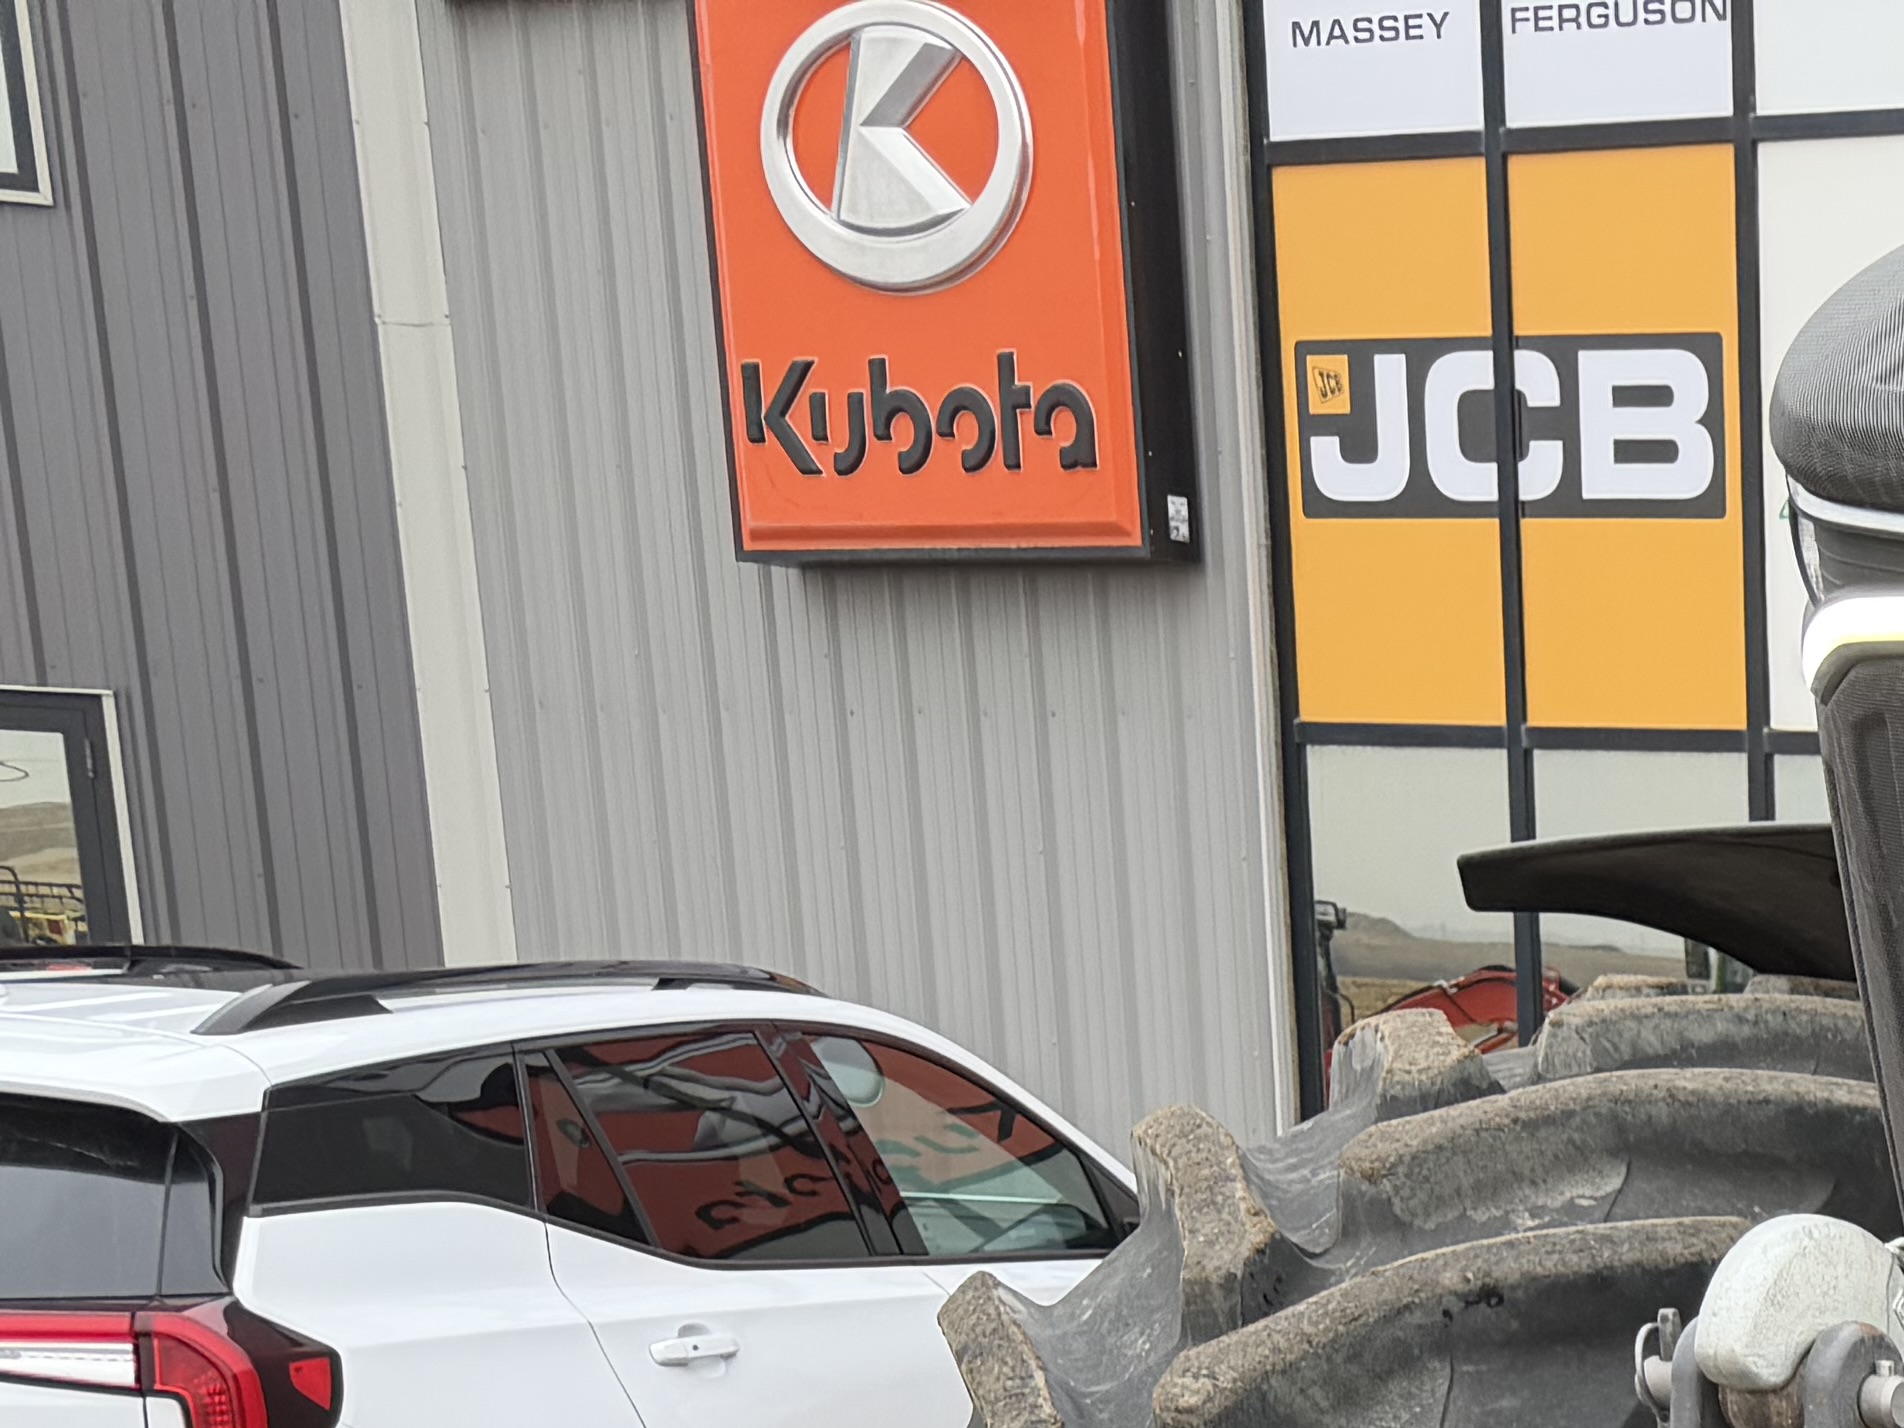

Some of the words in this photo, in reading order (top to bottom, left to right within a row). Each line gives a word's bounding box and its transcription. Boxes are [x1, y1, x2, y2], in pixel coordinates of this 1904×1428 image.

[1291, 12, 1450, 48] MASSEY
[1510, 0, 1728, 34] FERGUSON
[741, 350, 1098, 476] Kubota
[1310, 350, 1714, 501] JCB
